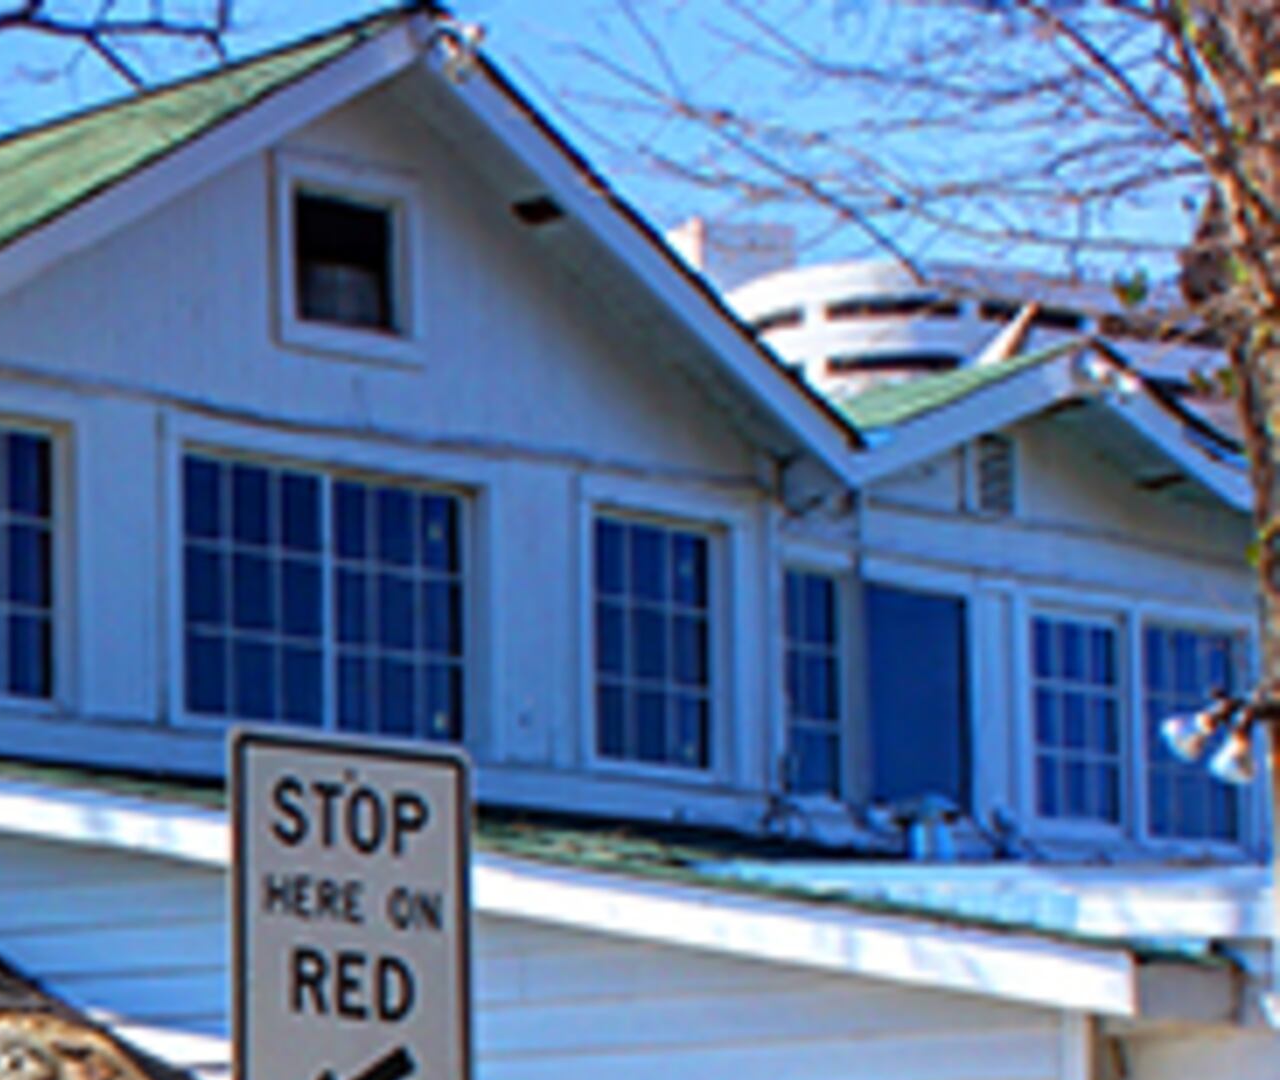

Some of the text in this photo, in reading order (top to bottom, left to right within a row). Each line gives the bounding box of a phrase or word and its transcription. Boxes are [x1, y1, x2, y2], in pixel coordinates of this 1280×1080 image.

[270, 776, 430, 857] STOP
[262, 874, 443, 933] HERE ON
[289, 946, 416, 1022] RED
